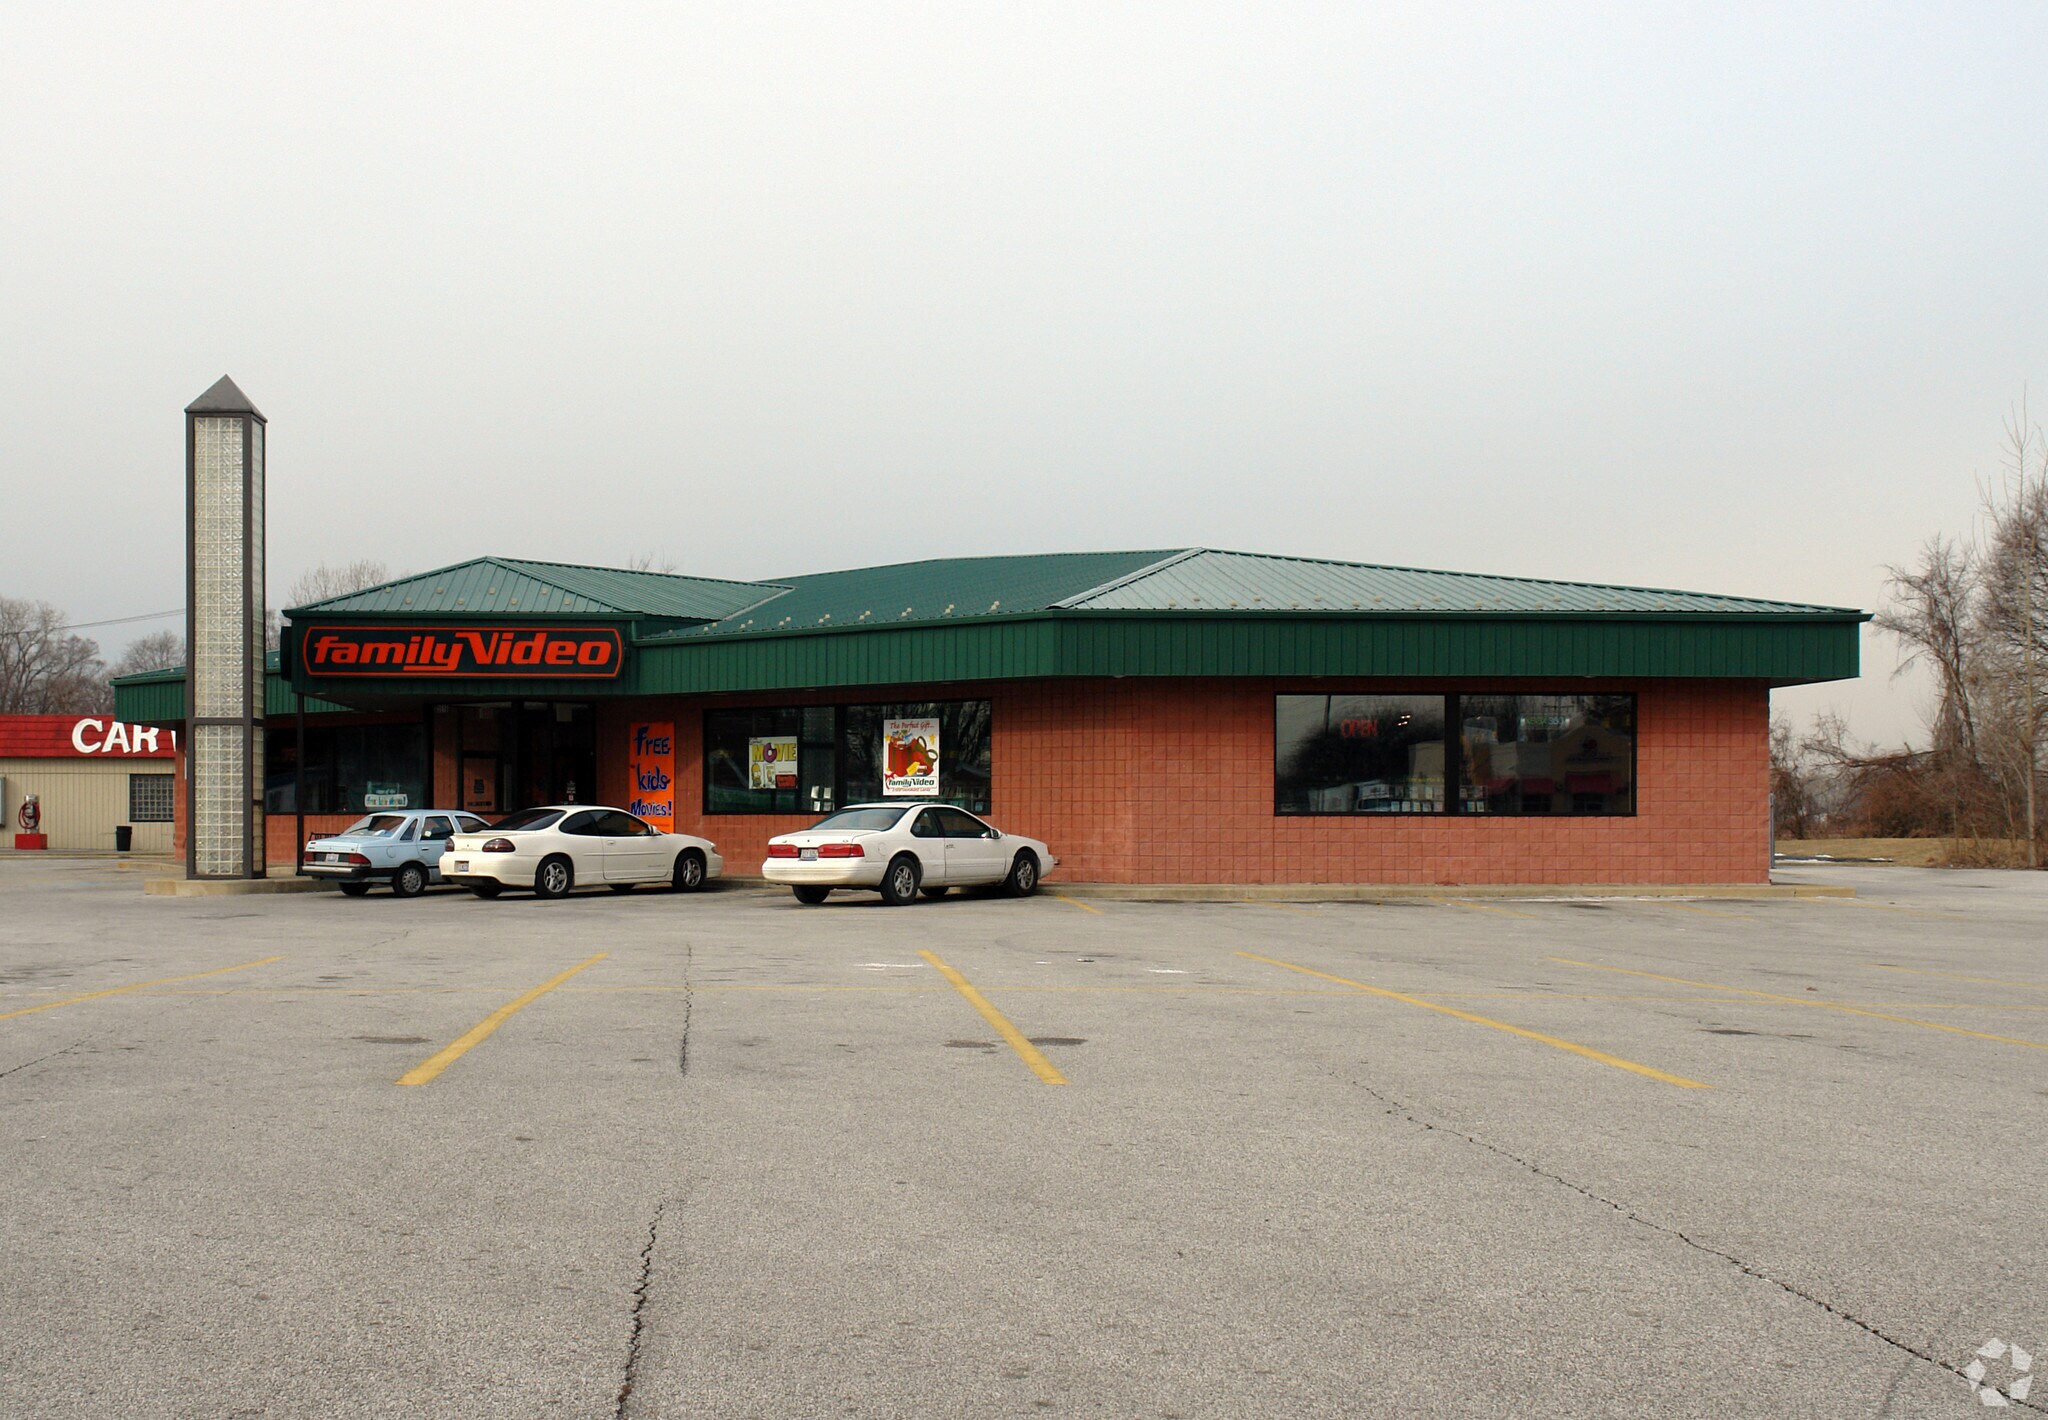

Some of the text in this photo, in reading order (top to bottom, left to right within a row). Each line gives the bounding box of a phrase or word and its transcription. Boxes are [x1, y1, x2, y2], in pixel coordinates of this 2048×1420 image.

[71, 718, 160, 754] CAR
[1340, 719, 1378, 737] OPEN
[752, 742, 797, 763] MOVIE
[636, 763, 668, 791] kids
